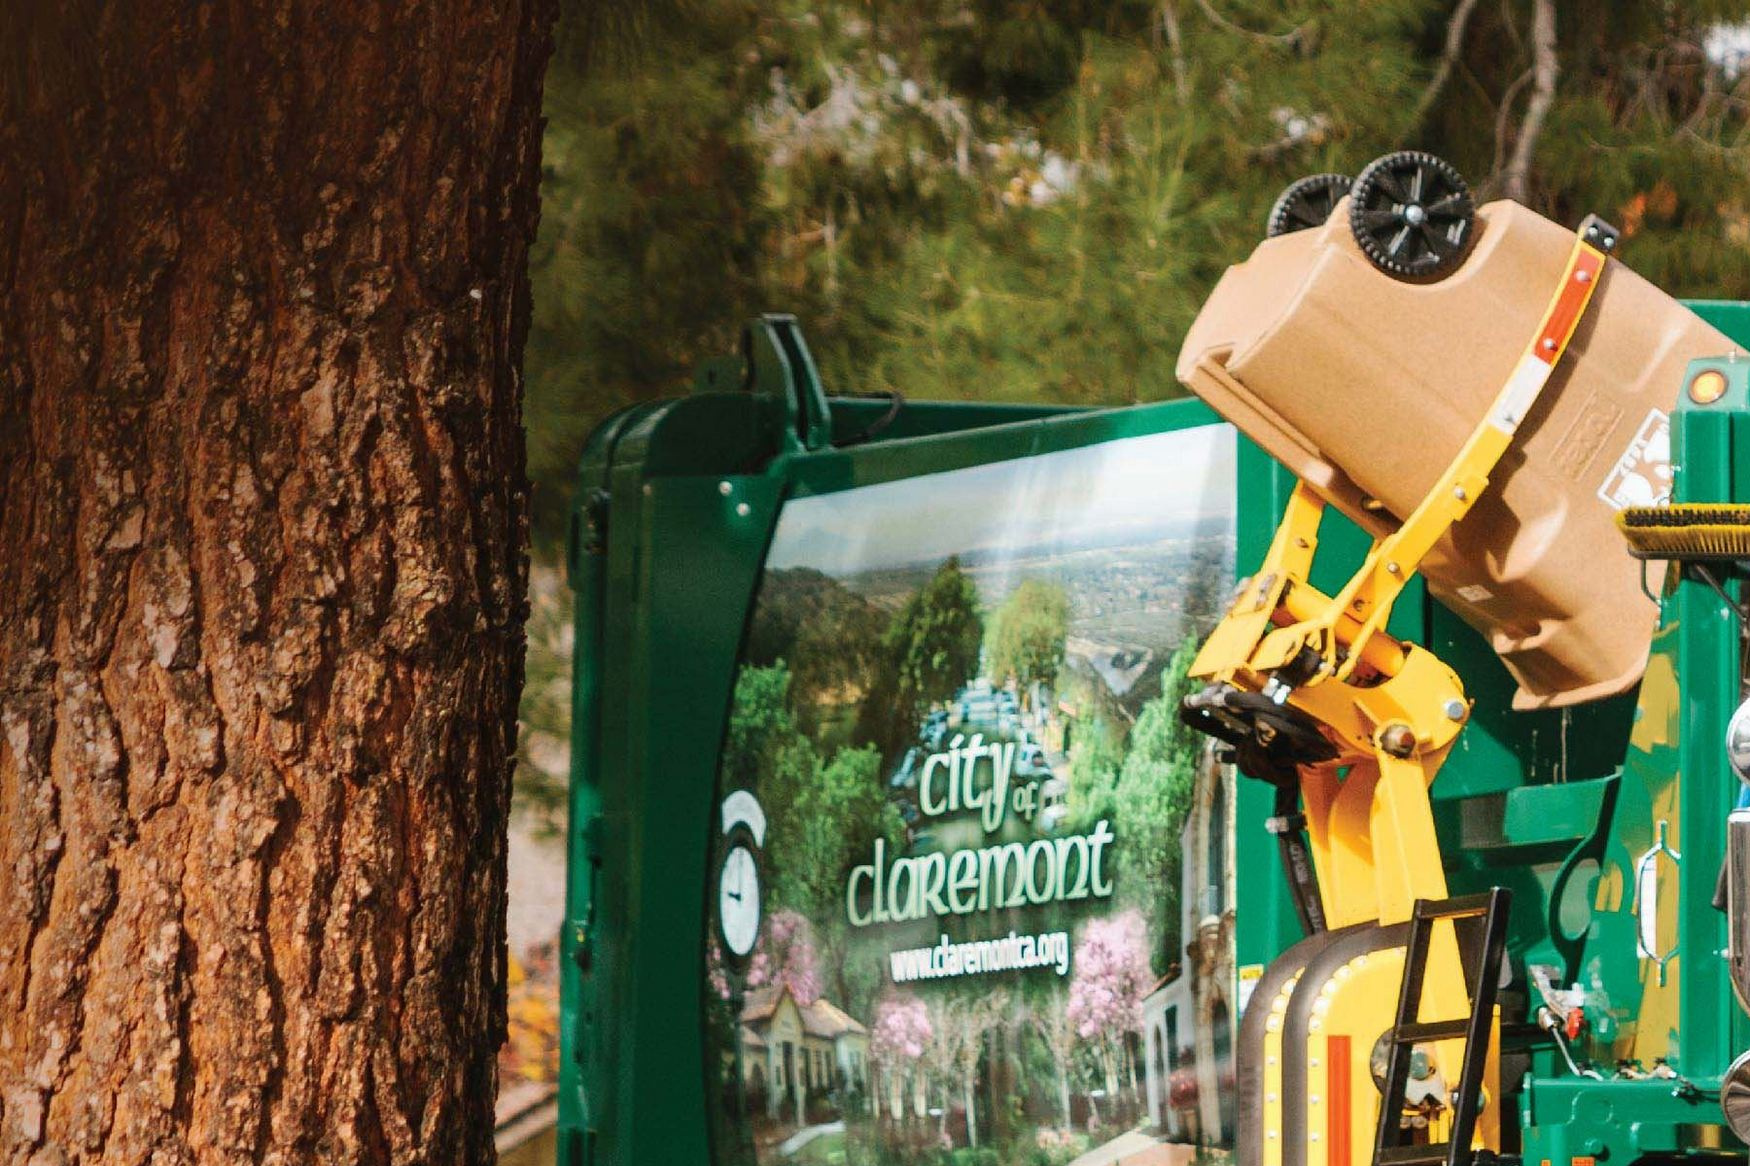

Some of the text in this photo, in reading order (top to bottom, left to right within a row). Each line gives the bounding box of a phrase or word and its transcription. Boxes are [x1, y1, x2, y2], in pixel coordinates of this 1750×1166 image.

[920, 733, 1015, 833] city
[847, 820, 1115, 926] claremont
[890, 931, 1068, 982] www.claremontca.org
